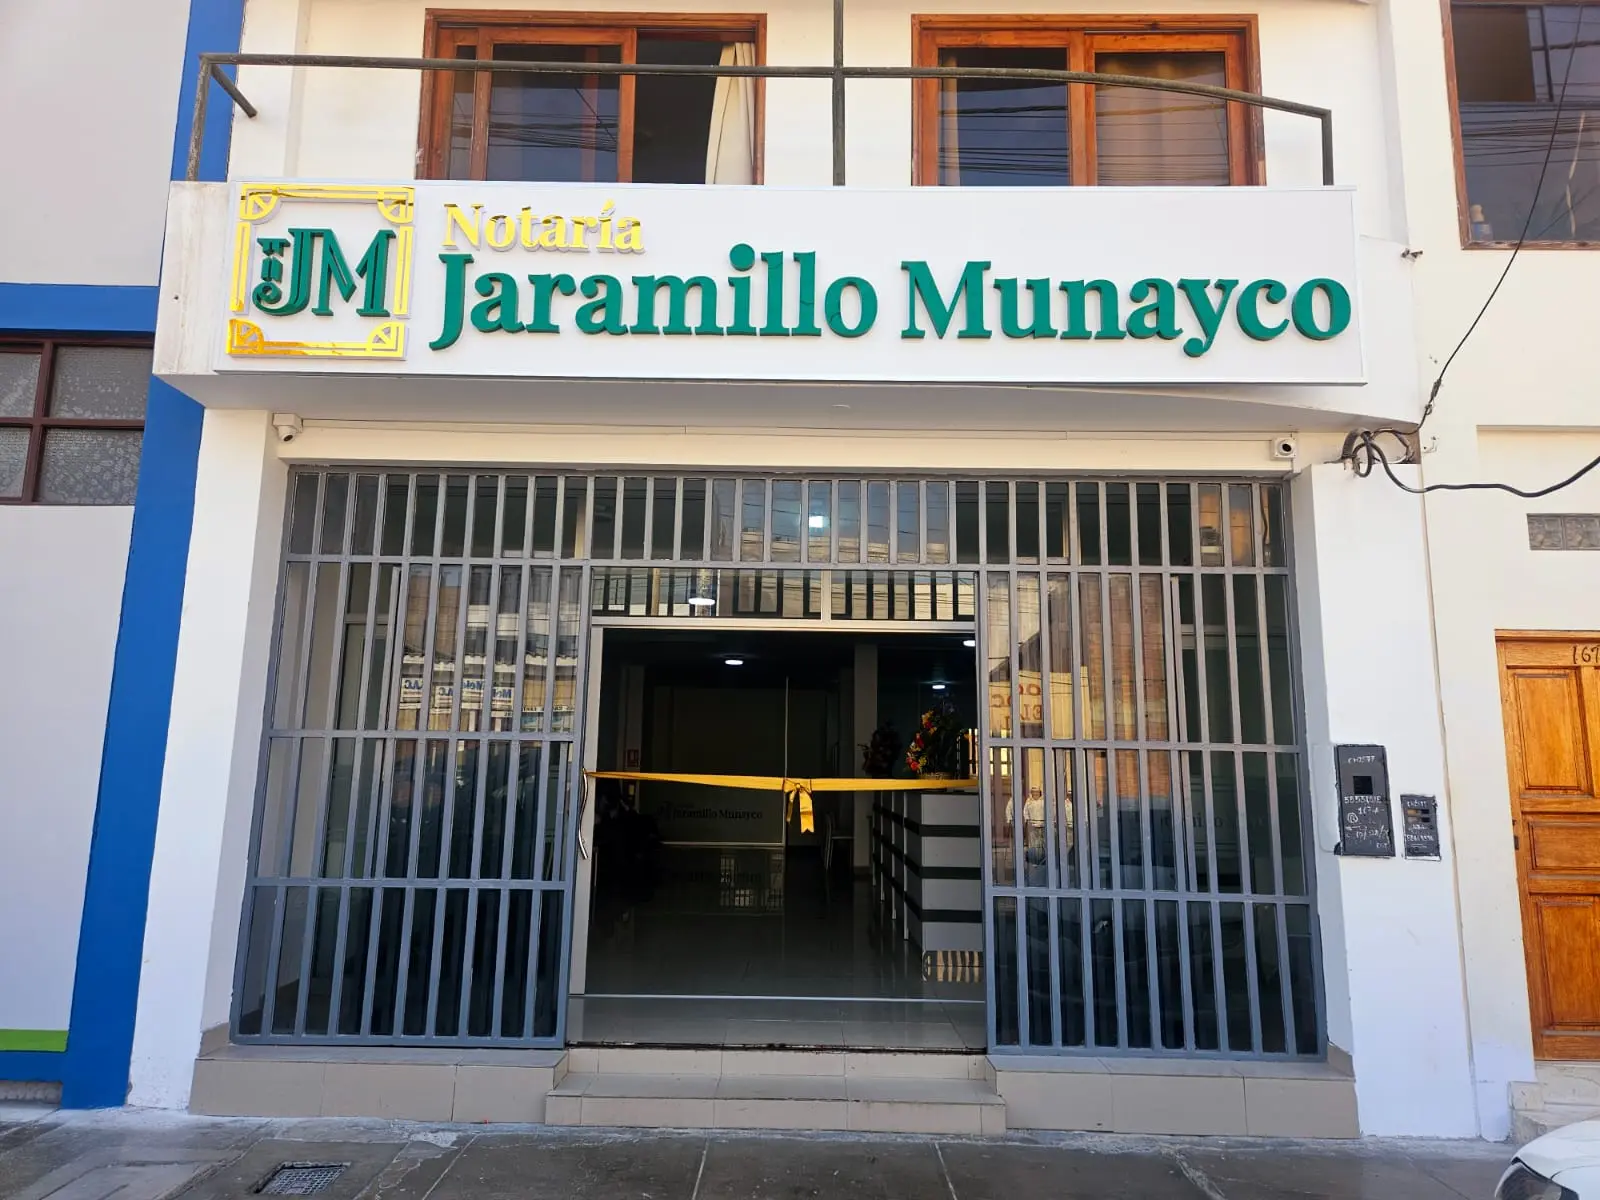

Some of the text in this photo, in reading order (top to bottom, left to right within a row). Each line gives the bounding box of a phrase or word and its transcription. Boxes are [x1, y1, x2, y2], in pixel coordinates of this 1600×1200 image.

[444, 200, 643, 252] Notaría
[429, 244, 1352, 357] Jaramillo Munayco
